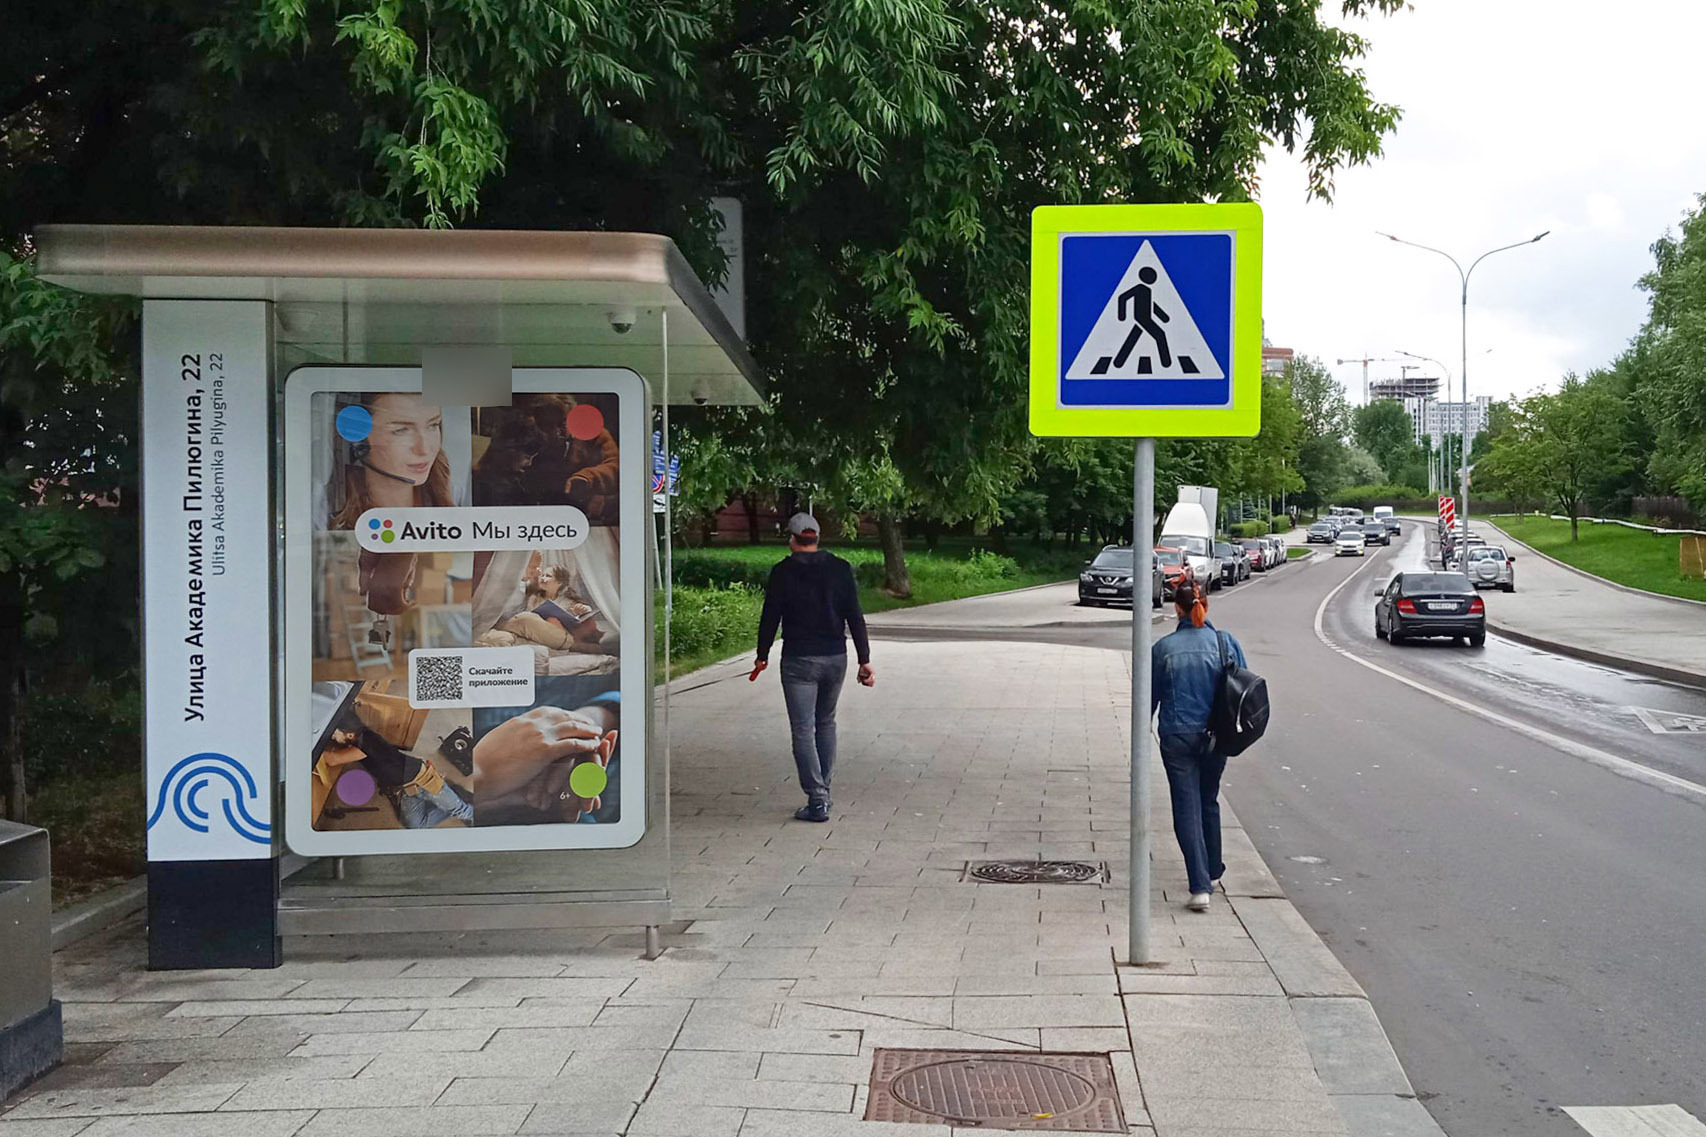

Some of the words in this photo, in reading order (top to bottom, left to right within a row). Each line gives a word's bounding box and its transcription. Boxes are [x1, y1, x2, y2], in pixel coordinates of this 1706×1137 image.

[181, 353, 202, 382] 22
[210, 352, 224, 371] 22
[210, 374, 227, 446] Pilyugina,
[182, 388, 206, 512] Пилюгина,
[210, 449, 226, 532] Akademika
[400, 521, 463, 540] Avito
[472, 521, 511, 539] Мы
[516, 523, 577, 542] здесь
[211, 535, 226, 576] Ulitsa
[184, 519, 207, 648] Академика
[185, 654, 207, 722] Улица
[468, 666, 513, 675] Скачайте
[468, 679, 528, 688] приложение
[559, 791, 571, 800] 6+
